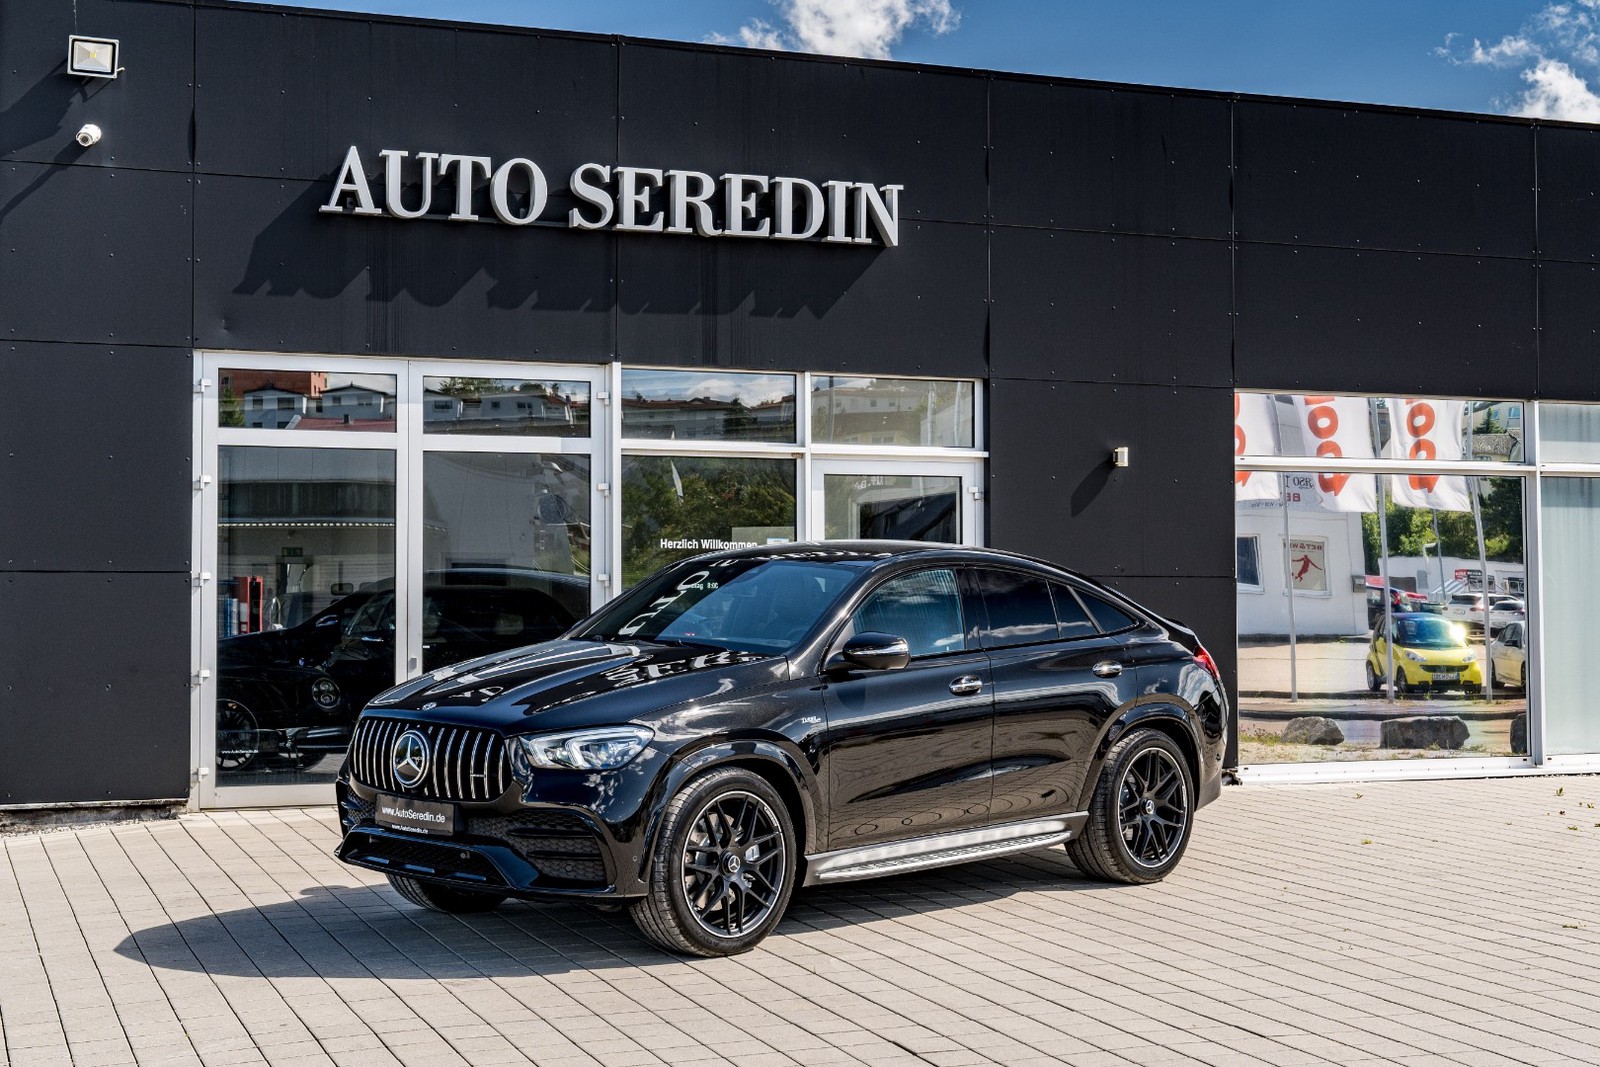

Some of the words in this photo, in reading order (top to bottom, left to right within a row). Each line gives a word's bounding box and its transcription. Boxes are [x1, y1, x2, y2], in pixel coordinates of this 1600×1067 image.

[319, 145, 548, 225] AUTO
[569, 163, 904, 247] SEREDIN
[660, 538, 699, 549] Herzlich
[381, 806, 446, 823] www.AutoSeredin.de
